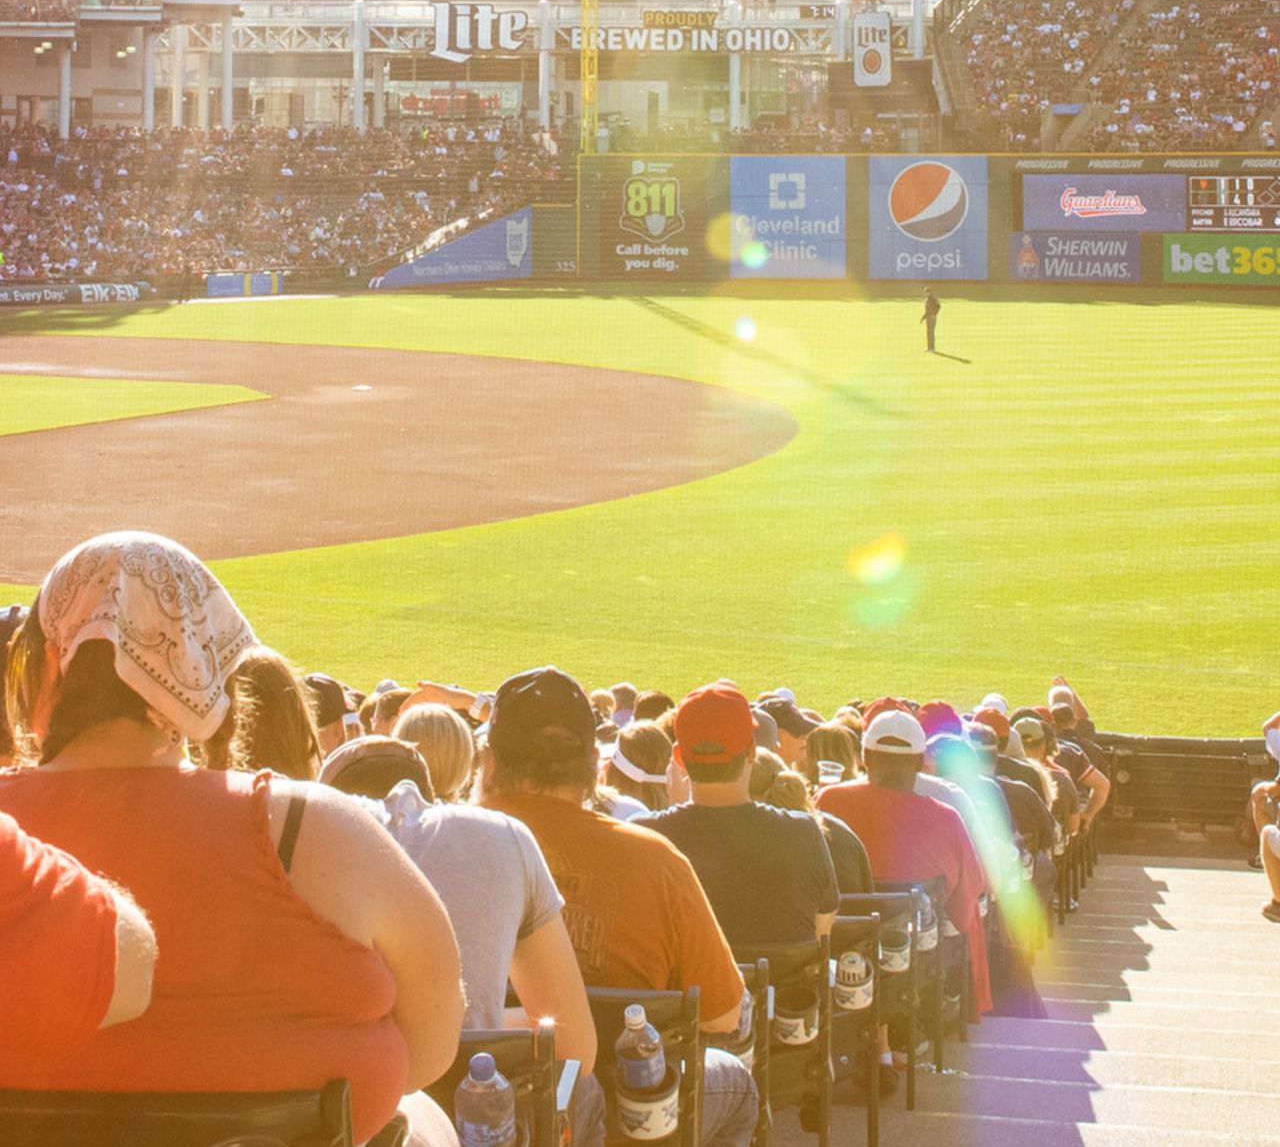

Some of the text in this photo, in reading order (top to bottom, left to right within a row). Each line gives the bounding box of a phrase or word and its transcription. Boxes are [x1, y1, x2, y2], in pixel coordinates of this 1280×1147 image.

[644, 12, 717, 27] PROUDLY
[429, 0, 529, 63] Lite
[690, 27, 719, 52] IN
[857, 25, 888, 49] Lite
[1163, 159, 1222, 169] PROGRESSIVE
[627, 181, 676, 217] 811
[1061, 187, 1147, 219] Guardians
[735, 214, 841, 236] Cleveland
[1229, 217, 1263, 227] ESCOBAR
[615, 243, 690, 257] Call before
[1046, 236, 1128, 257] SHERWIN
[625, 257, 680, 272] you dig.
[896, 249, 961, 272] pepsi
[14, 290, 42, 303] Every
